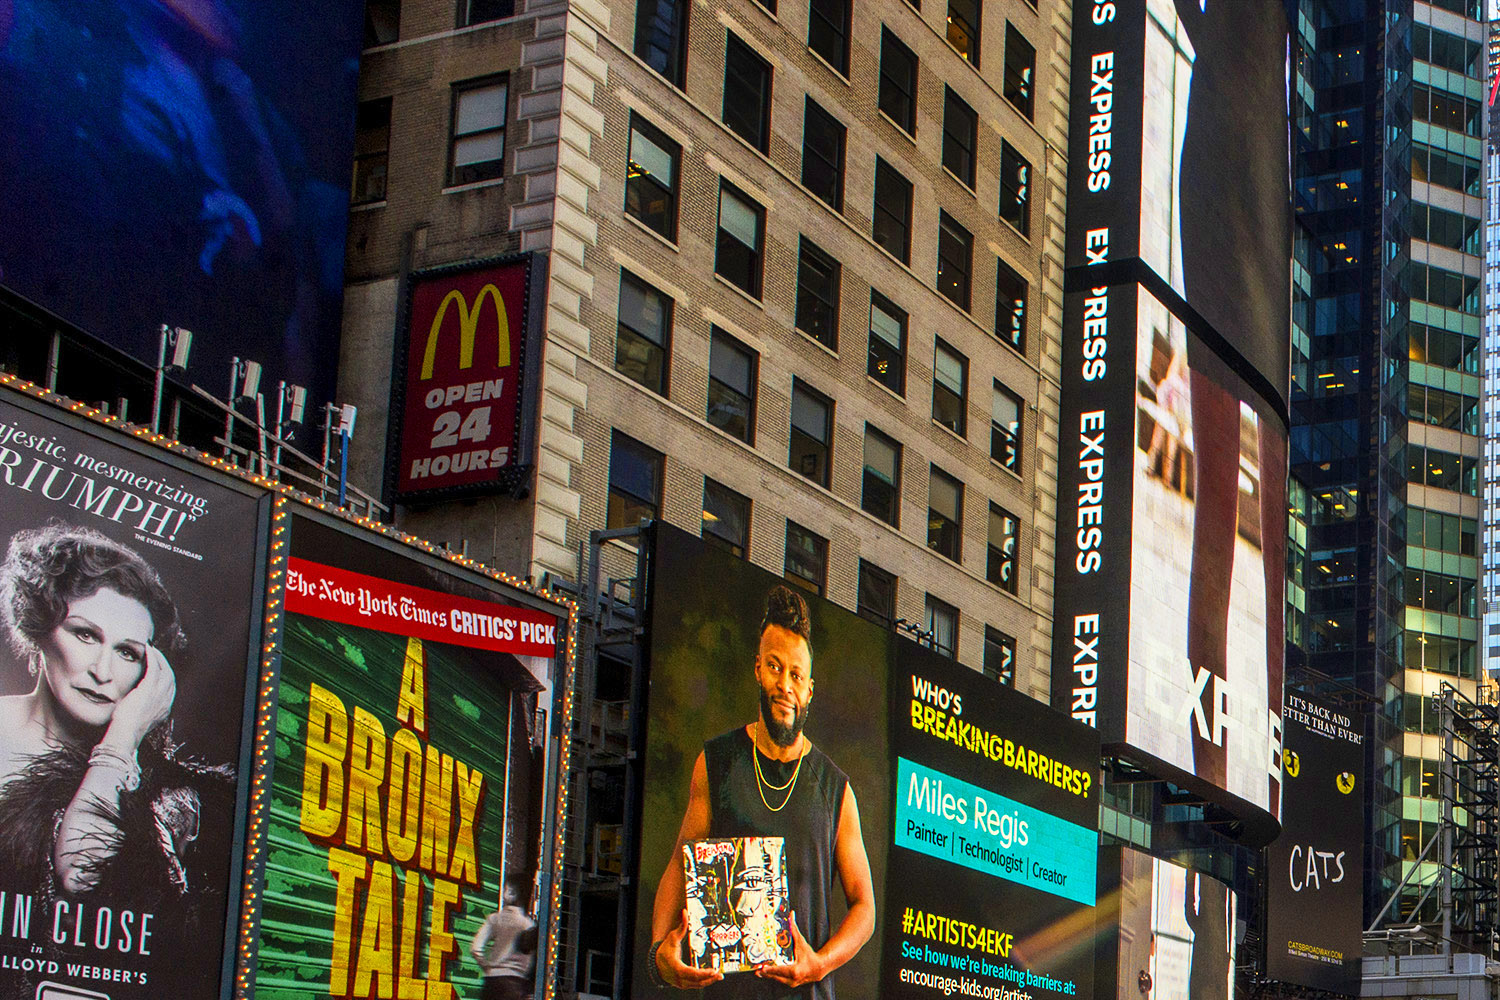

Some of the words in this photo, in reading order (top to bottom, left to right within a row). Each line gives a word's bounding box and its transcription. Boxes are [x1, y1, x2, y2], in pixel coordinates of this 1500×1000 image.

[1087, 51, 1114, 194] EXPRESS
[424, 378, 503, 409] OPEN
[430, 407, 492, 448] 24
[74, 451, 208, 517] mesmerizing,
[410, 446, 509, 480] HOURS
[1074, 409, 1105, 575] EXPRESS
[286, 569, 316, 598] The
[319, 579, 356, 610] New
[358, 586, 398, 617] York
[399, 595, 448, 630] Times
[451, 608, 518, 643] CRITICS'
[521, 618, 556, 646] PICK
[397, 636, 428, 733] A
[912, 675, 962, 715] WHO'S
[1289, 695, 1306, 711] IT'S
[1308, 702, 1330, 720] BACK
[1332, 713, 1351, 728] AND
[1312, 716, 1336, 735] THAN
[300, 682, 483, 885] BRONX
[908, 772, 967, 825] Miles
[974, 796, 1029, 849] Regis
[907, 819, 948, 848] Painter
[959, 836, 1023, 874] Technologist
[1032, 862, 1068, 886] Creator
[1289, 844, 1345, 892] CATS
[53, 900, 154, 956] CLOSE
[902, 906, 1014, 958] #ARTISTS4EKF
[1287, 940, 1343, 960] CATSBROADWAY.COM
[2, 955, 59, 974] LLOYD
[66, 963, 148, 985] WEBBER'S
[902, 940, 922, 960] See
[925, 945, 948, 966] how
[950, 952, 980, 974] we're
[981, 958, 1025, 987] breaking
[1026, 969, 1062, 992] barriers
